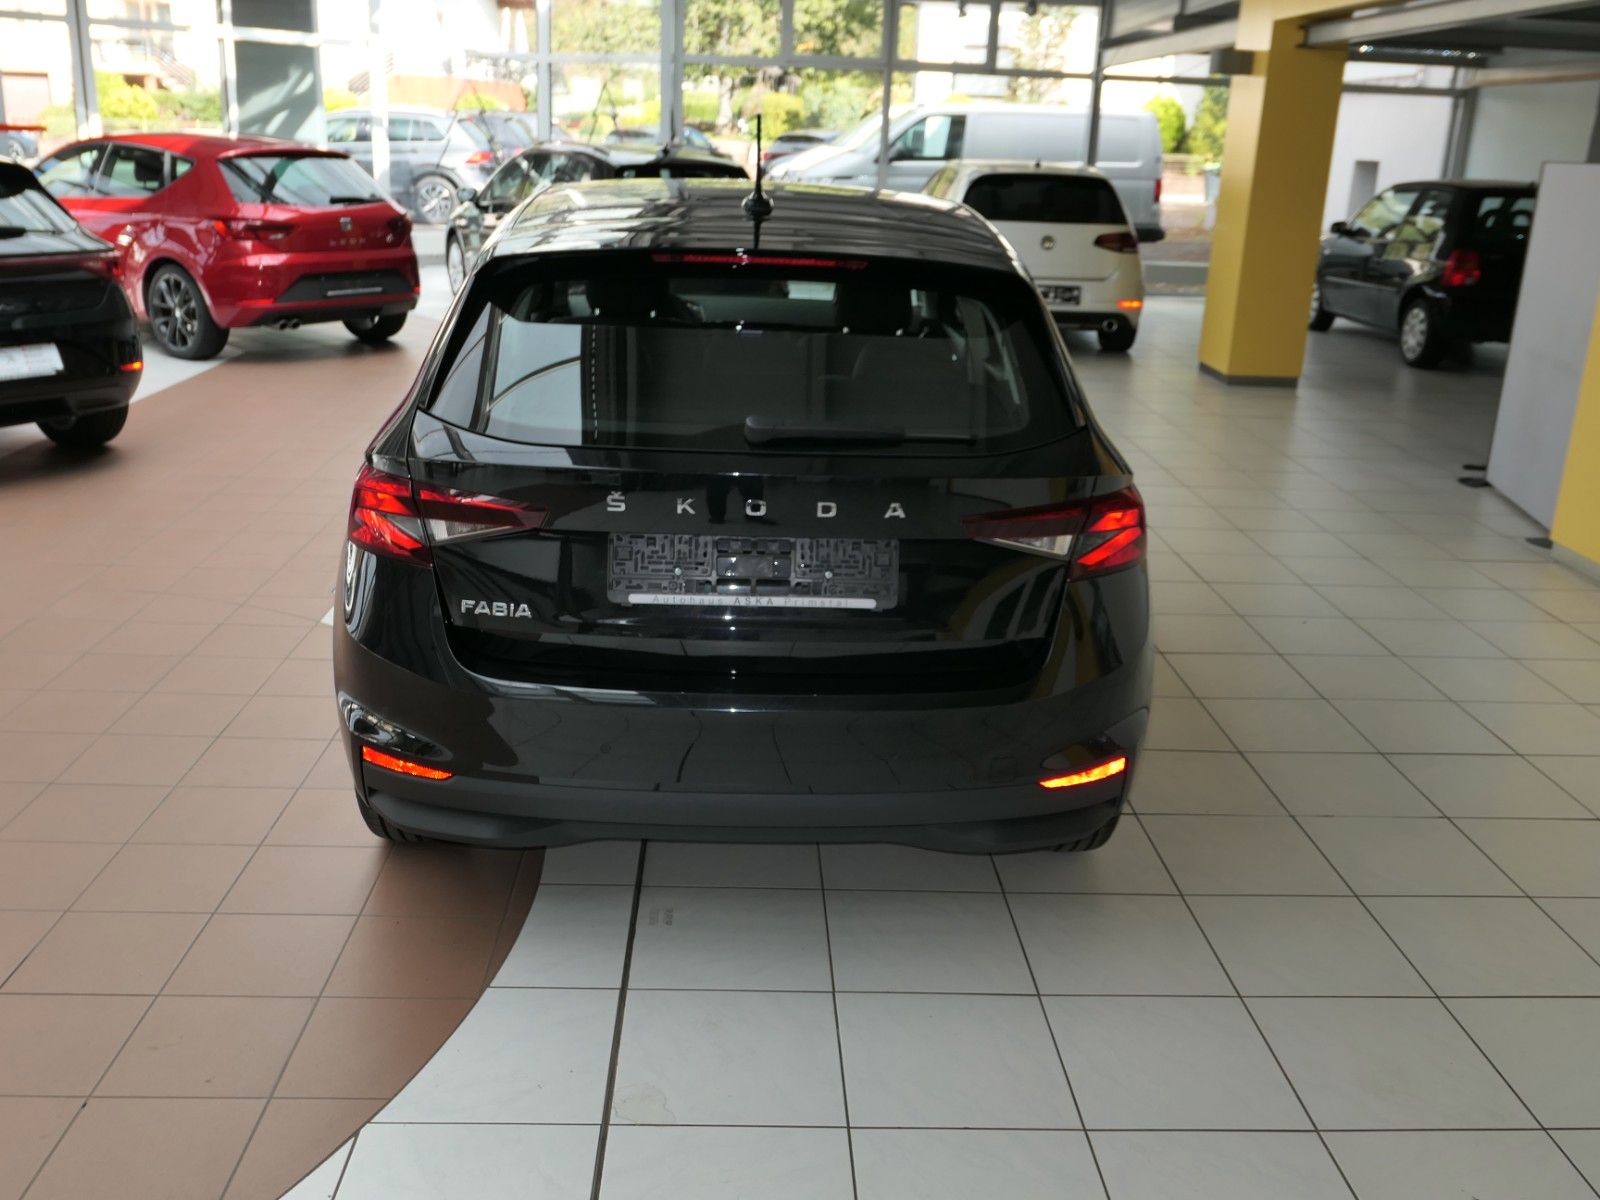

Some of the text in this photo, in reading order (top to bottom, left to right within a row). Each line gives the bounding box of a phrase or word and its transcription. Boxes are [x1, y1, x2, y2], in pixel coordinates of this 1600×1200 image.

[606, 491, 906, 519] ŠKODA
[461, 599, 532, 618] FABIA
[733, 597, 774, 607] ASKA
